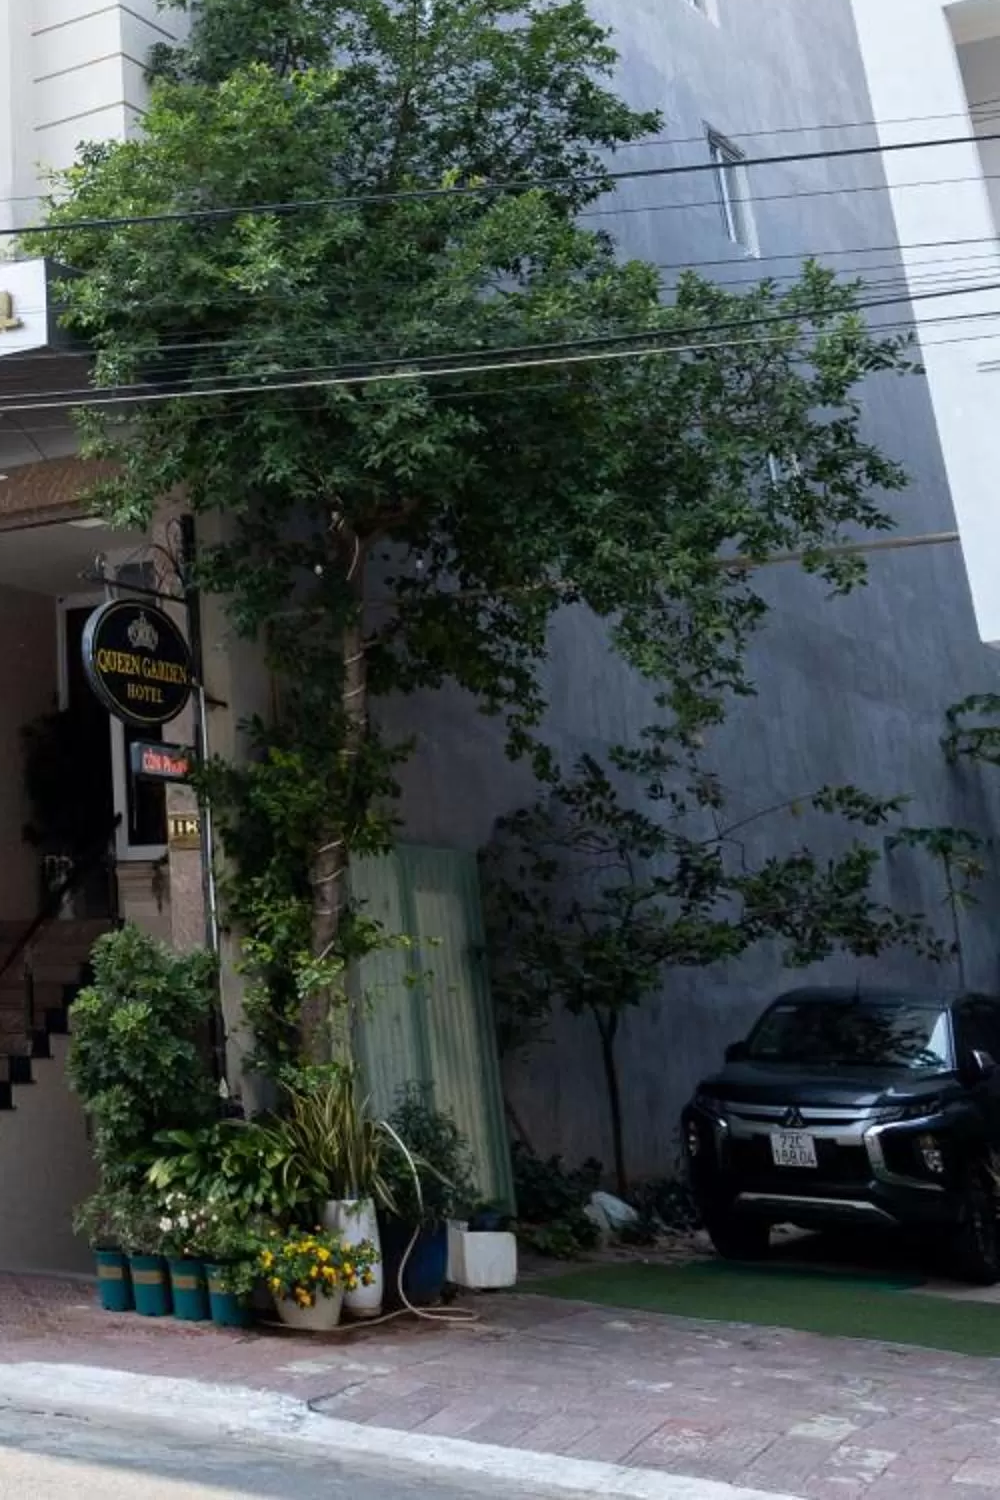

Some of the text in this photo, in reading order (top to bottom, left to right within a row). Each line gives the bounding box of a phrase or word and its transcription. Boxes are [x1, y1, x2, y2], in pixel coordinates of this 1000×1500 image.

[97, 648, 188, 684] QUEEN GARDEN
[127, 683, 164, 703] HOTEL
